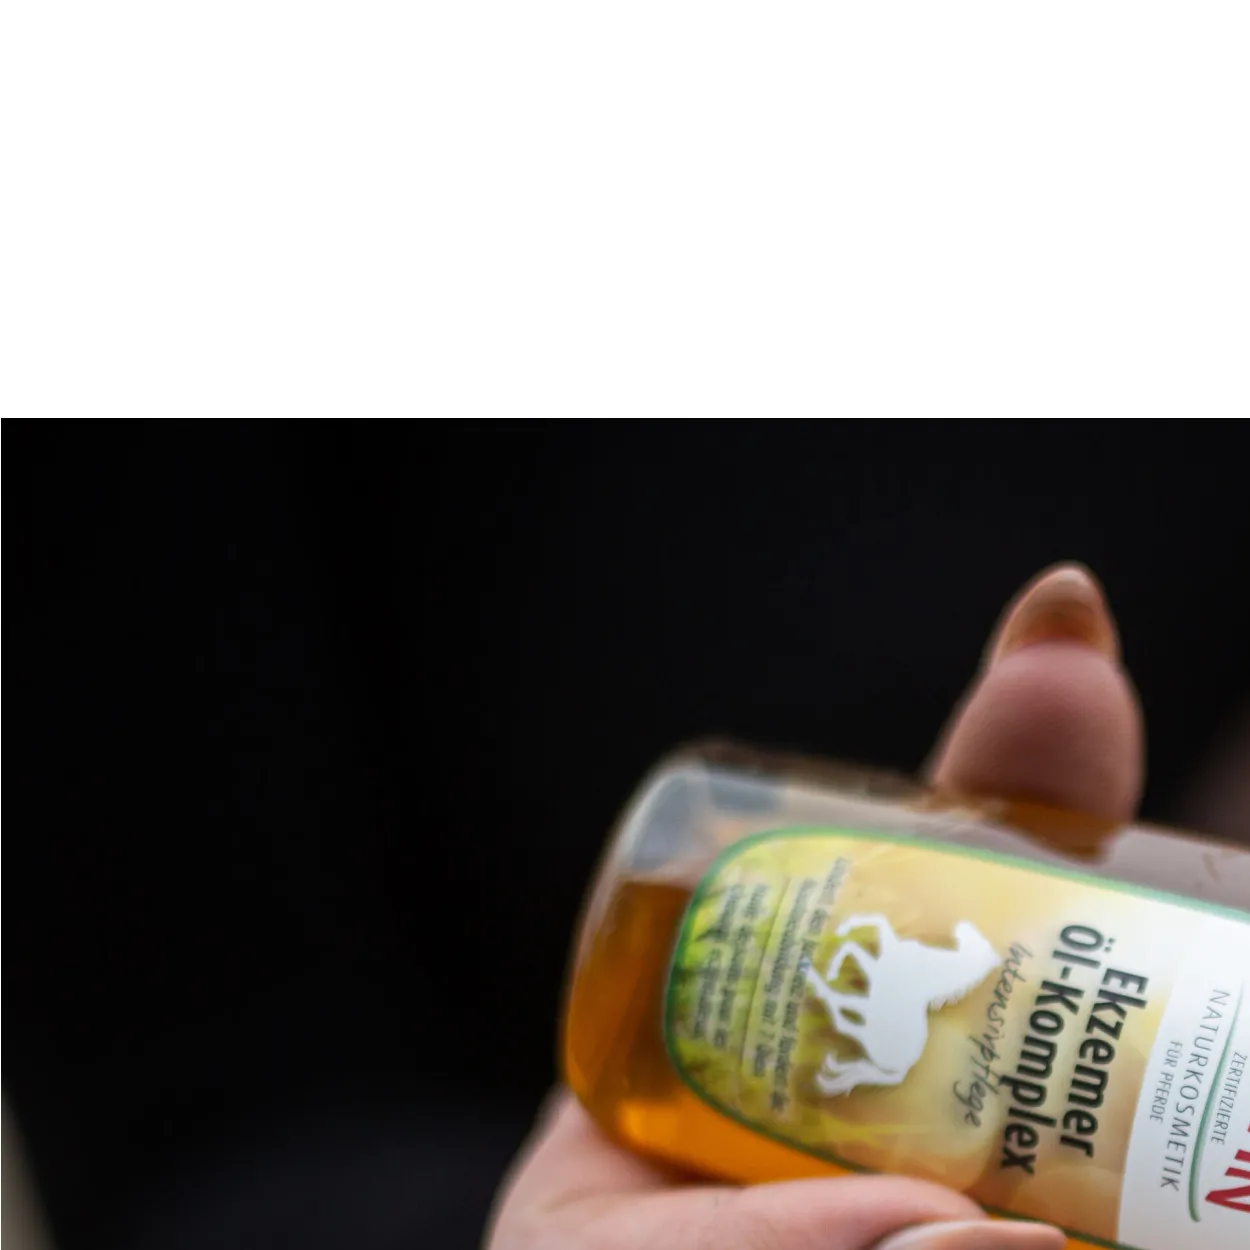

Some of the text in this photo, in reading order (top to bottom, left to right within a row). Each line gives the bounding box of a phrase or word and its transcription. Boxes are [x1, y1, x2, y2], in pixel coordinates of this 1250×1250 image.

[1001, 924, 1116, 1176] Öl-Komplex
[1060, 968, 1148, 1158] Ekzemer
[1150, 1041, 1183, 1124] FÜR PFERDE
[1160, 989, 1231, 1192] NATURKOSMETIK
[1211, 1051, 1248, 1145] ZERTIFIZIERTE
